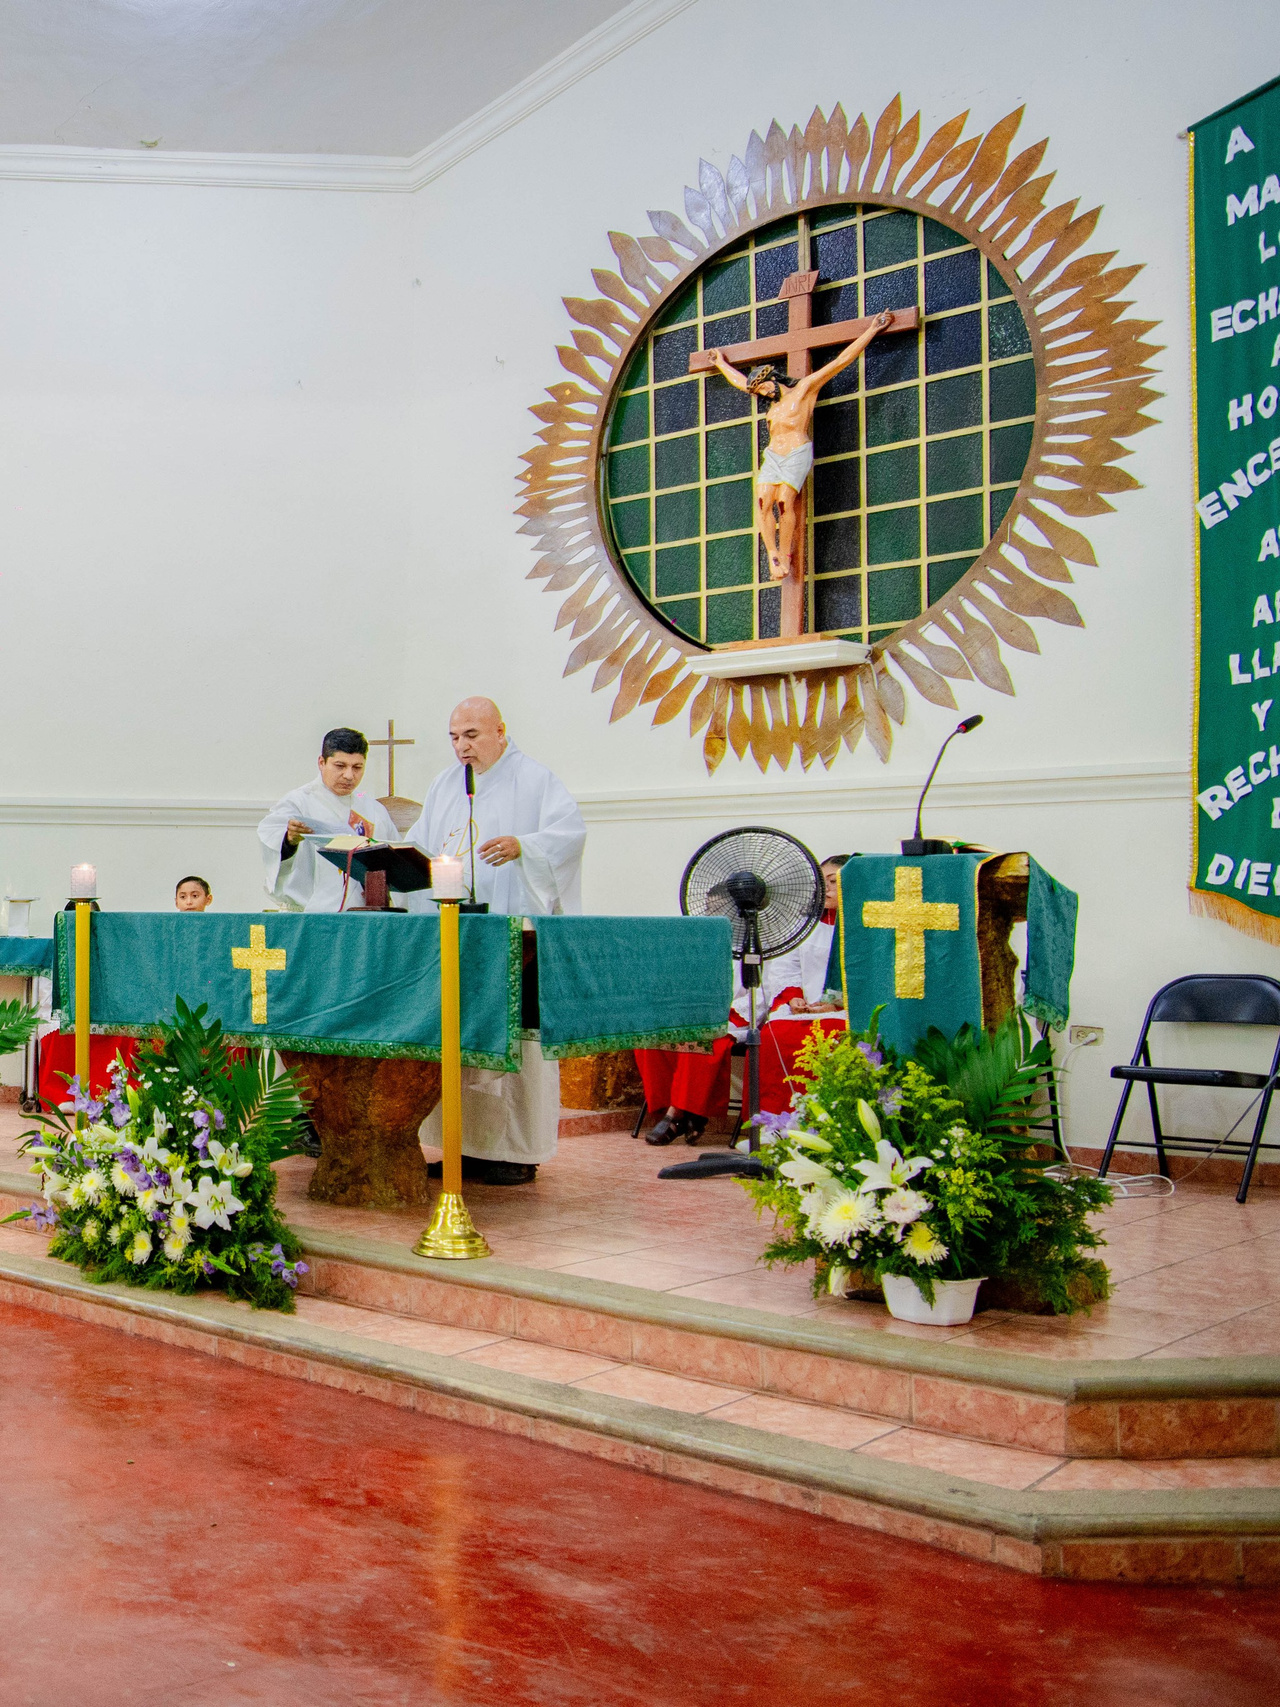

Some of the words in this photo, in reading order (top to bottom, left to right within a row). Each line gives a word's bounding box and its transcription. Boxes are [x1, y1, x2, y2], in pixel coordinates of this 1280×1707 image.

[1225, 125, 1255, 165] A
[1258, 231, 1280, 264] L
[785, 273, 812, 296] INRI
[1210, 286, 1280, 343] ECH
[1258, 524, 1280, 562] A
[1251, 699, 1273, 732] Y
